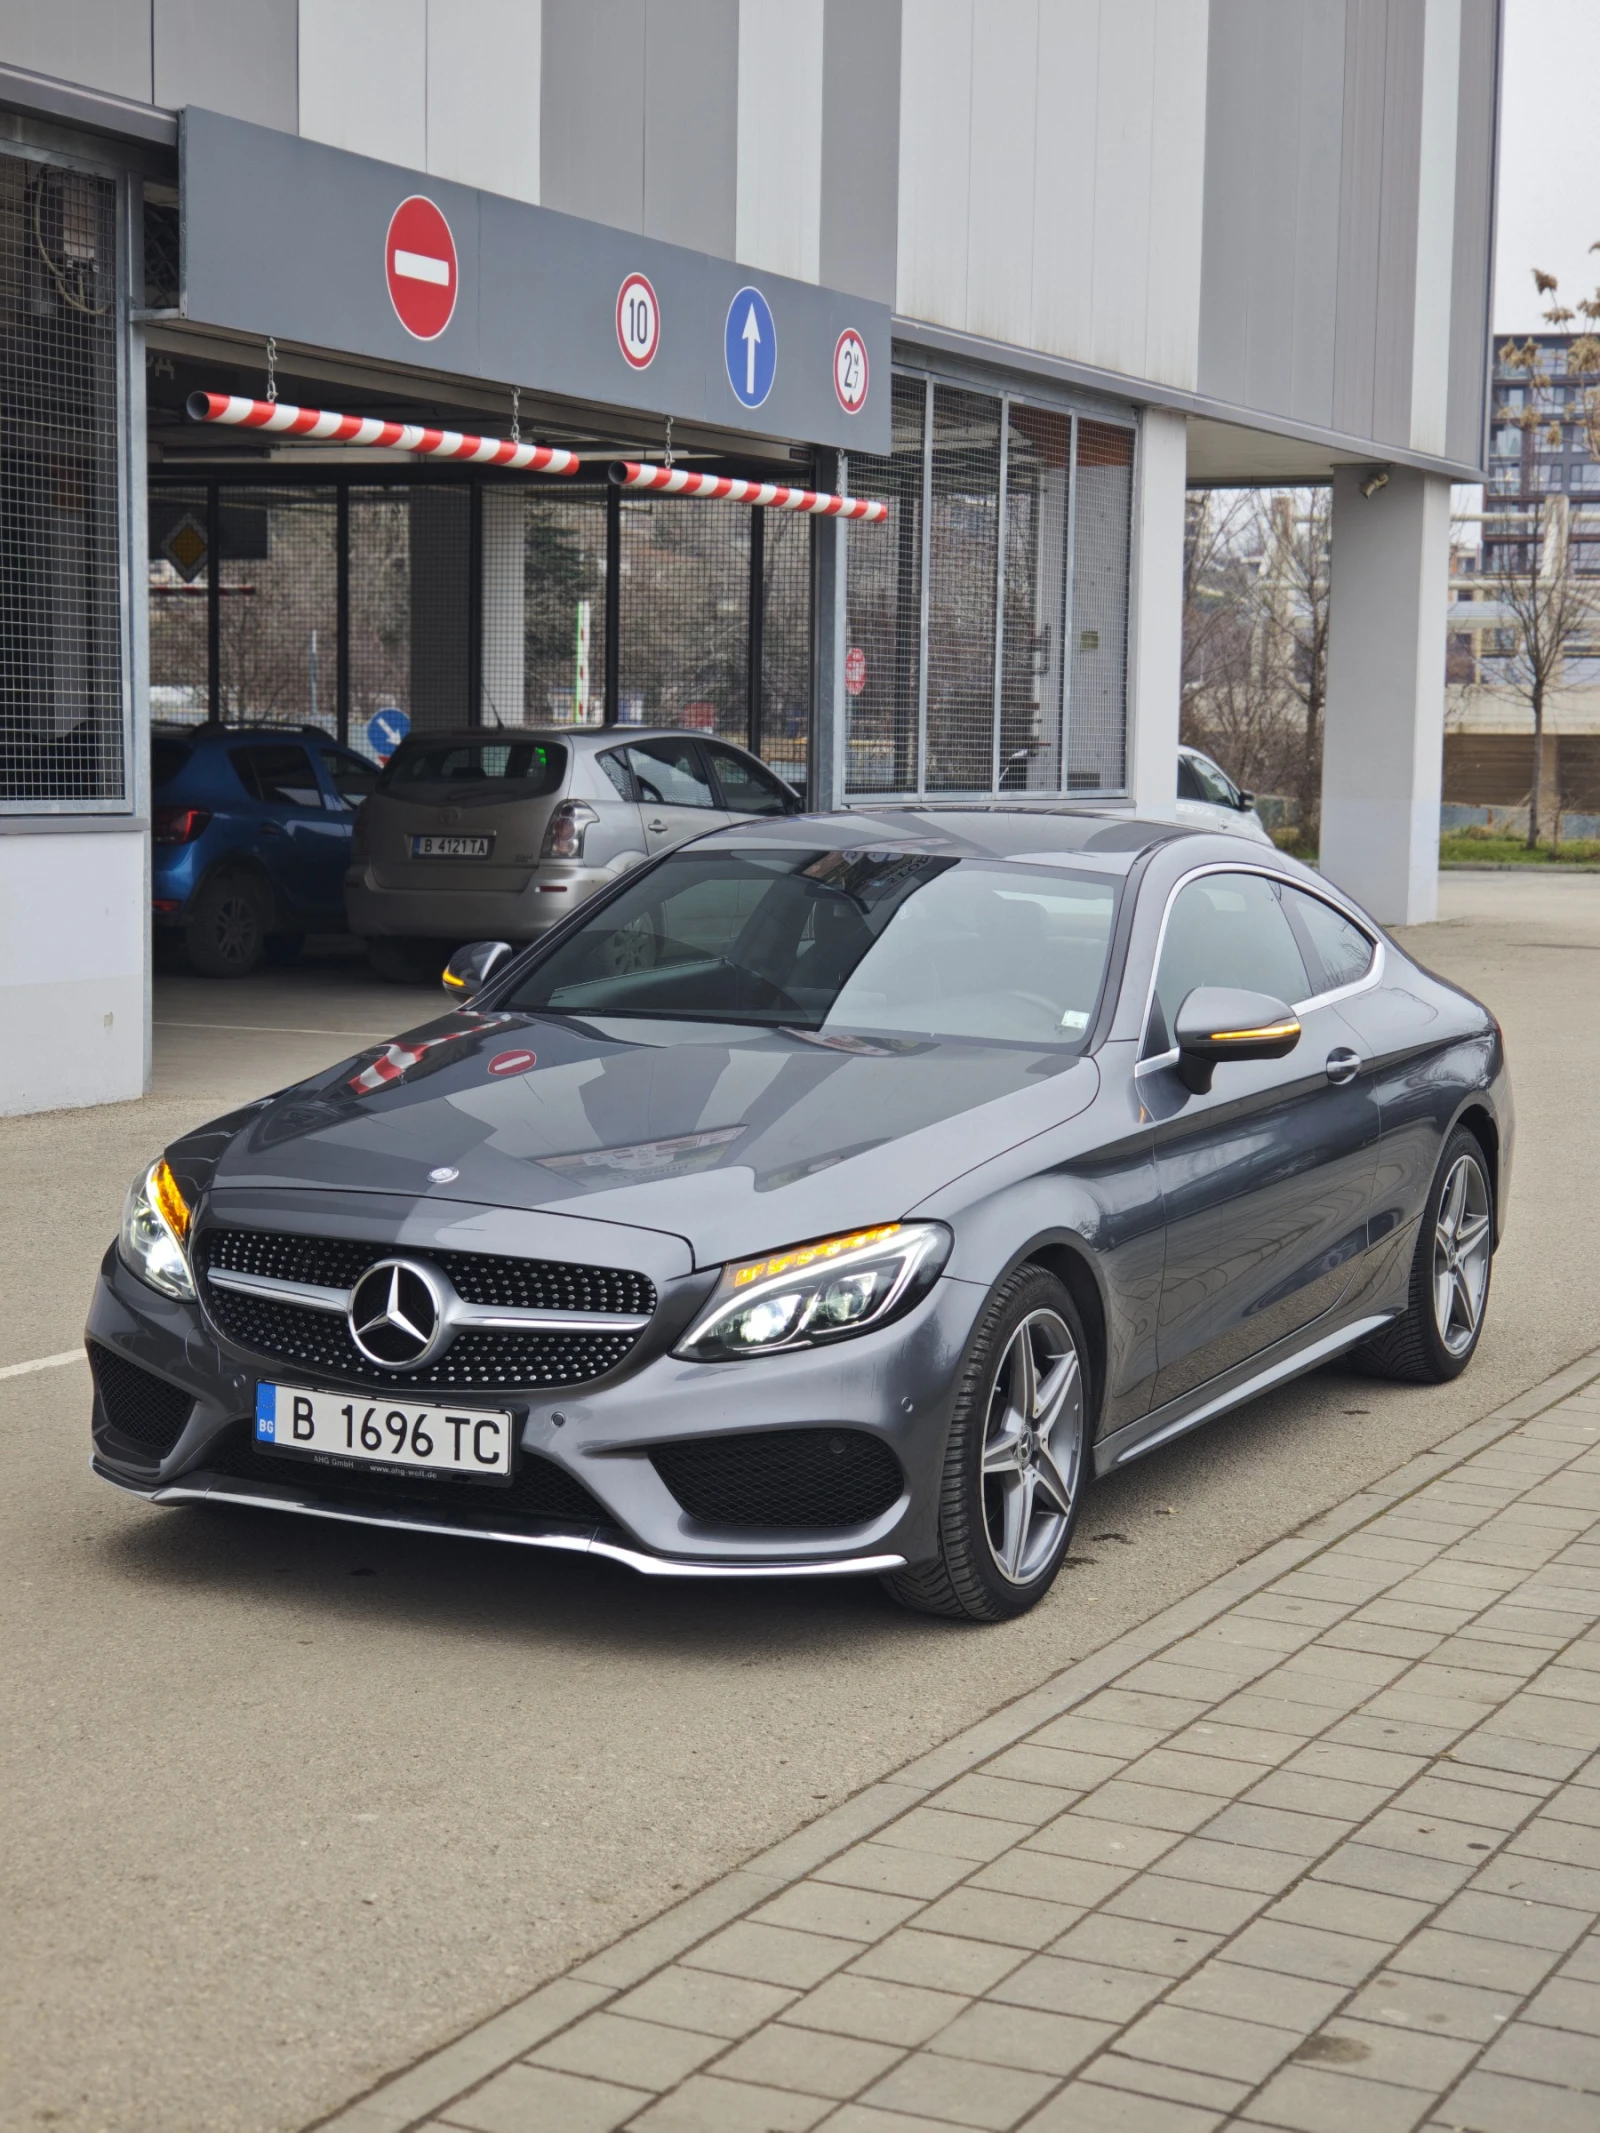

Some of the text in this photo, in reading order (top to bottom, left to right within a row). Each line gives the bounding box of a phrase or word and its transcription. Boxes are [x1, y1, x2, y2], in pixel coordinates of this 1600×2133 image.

[629, 297, 648, 345] 10
[424, 838, 433, 853] B
[438, 839, 467, 854] 4121
[471, 839, 486, 855] TA
[258, 1418, 274, 1434] BG
[292, 1396, 501, 1465] B 1696 TC
[313, 1455, 330, 1465] AHG
[331, 1458, 354, 1469] GmbH
